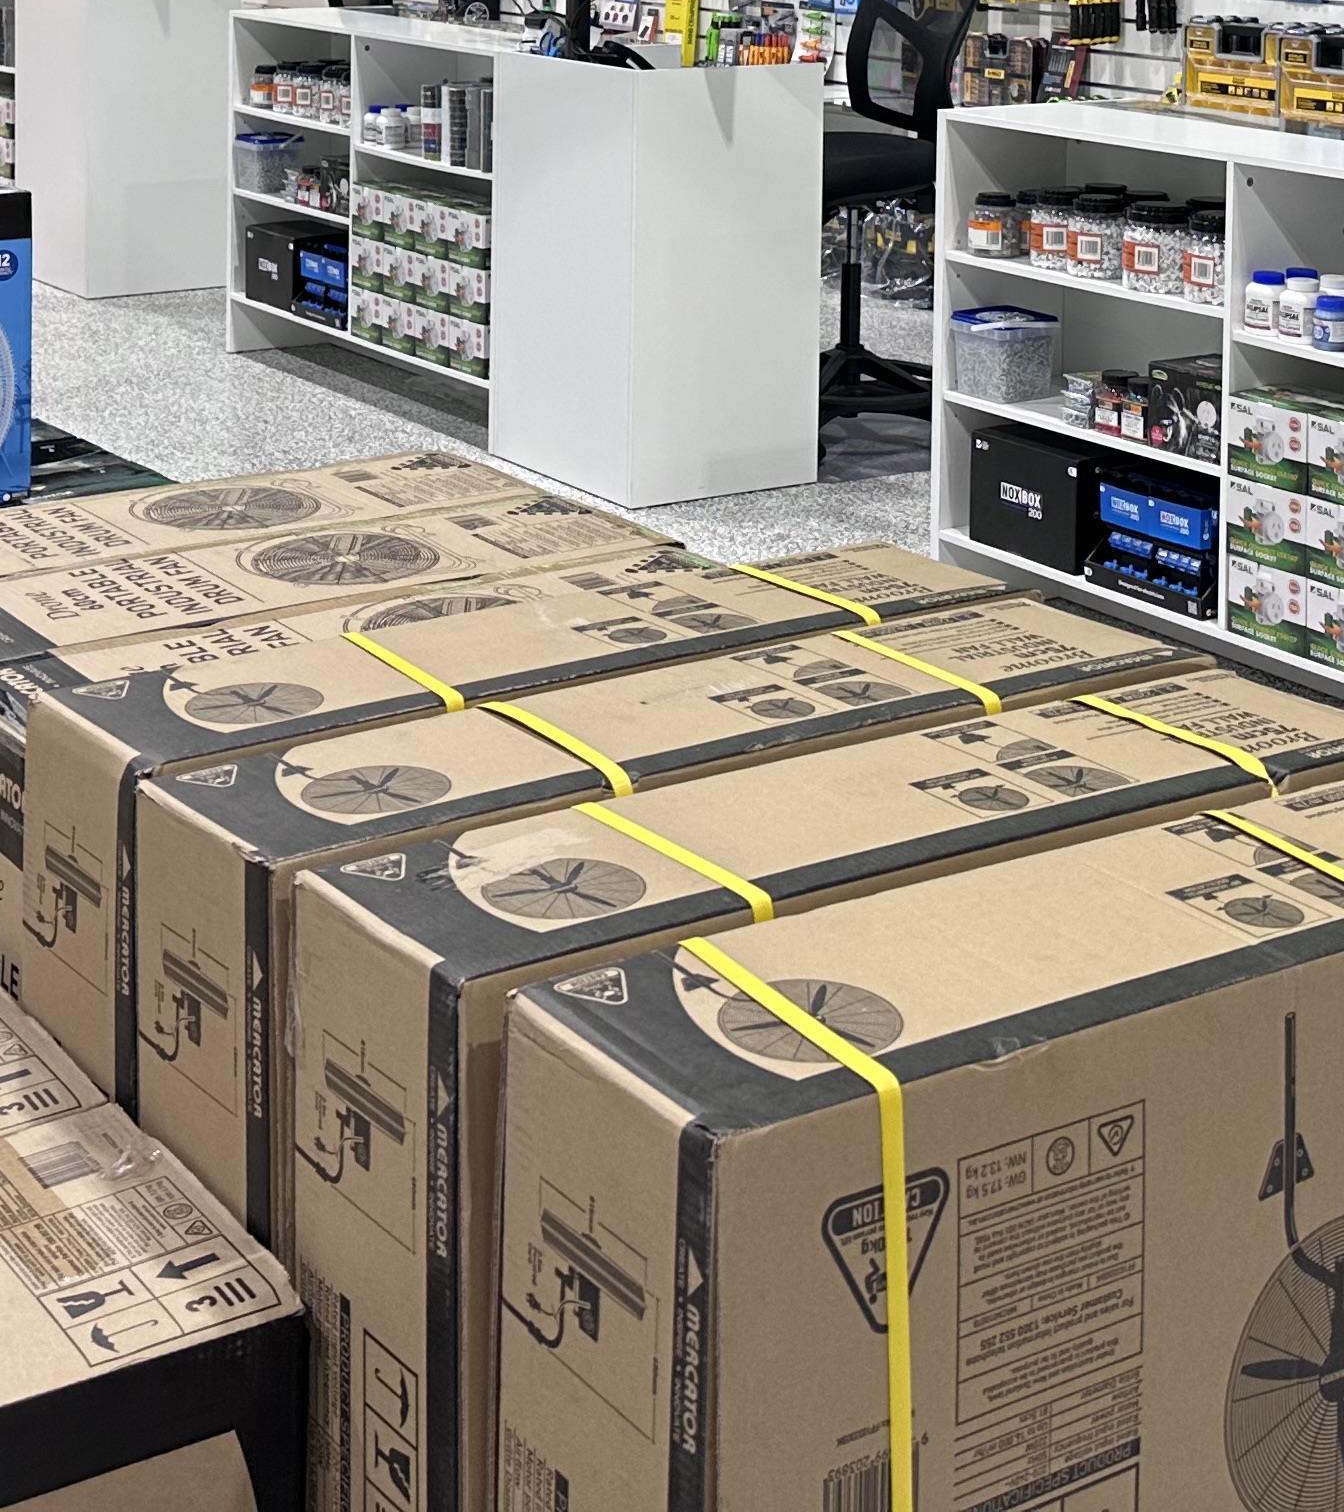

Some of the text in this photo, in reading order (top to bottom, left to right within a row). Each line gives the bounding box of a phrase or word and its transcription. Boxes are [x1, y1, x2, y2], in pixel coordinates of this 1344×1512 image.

[1026, 506, 1043, 521] 200
[68, 567, 168, 620] PORTABLE
[103, 557, 214, 616] INDUSTRIAL
[142, 555, 246, 606] DRUM FAN
[25, 591, 82, 621] Drone
[61, 588, 105, 612] 60cm
[964, 1153, 1027, 1182] NW: 13.2 kg
[435, 1123, 451, 1258] MERCATOR
[965, 1184, 980, 1202] kg
[981, 1177, 1003, 1195] 17.5
[979, 1287, 1124, 1351] Customer Service: 1300 552 255
[682, 1302, 701, 1456] MERCATOR
[1071, 1442, 1133, 1477] PRODUCT
